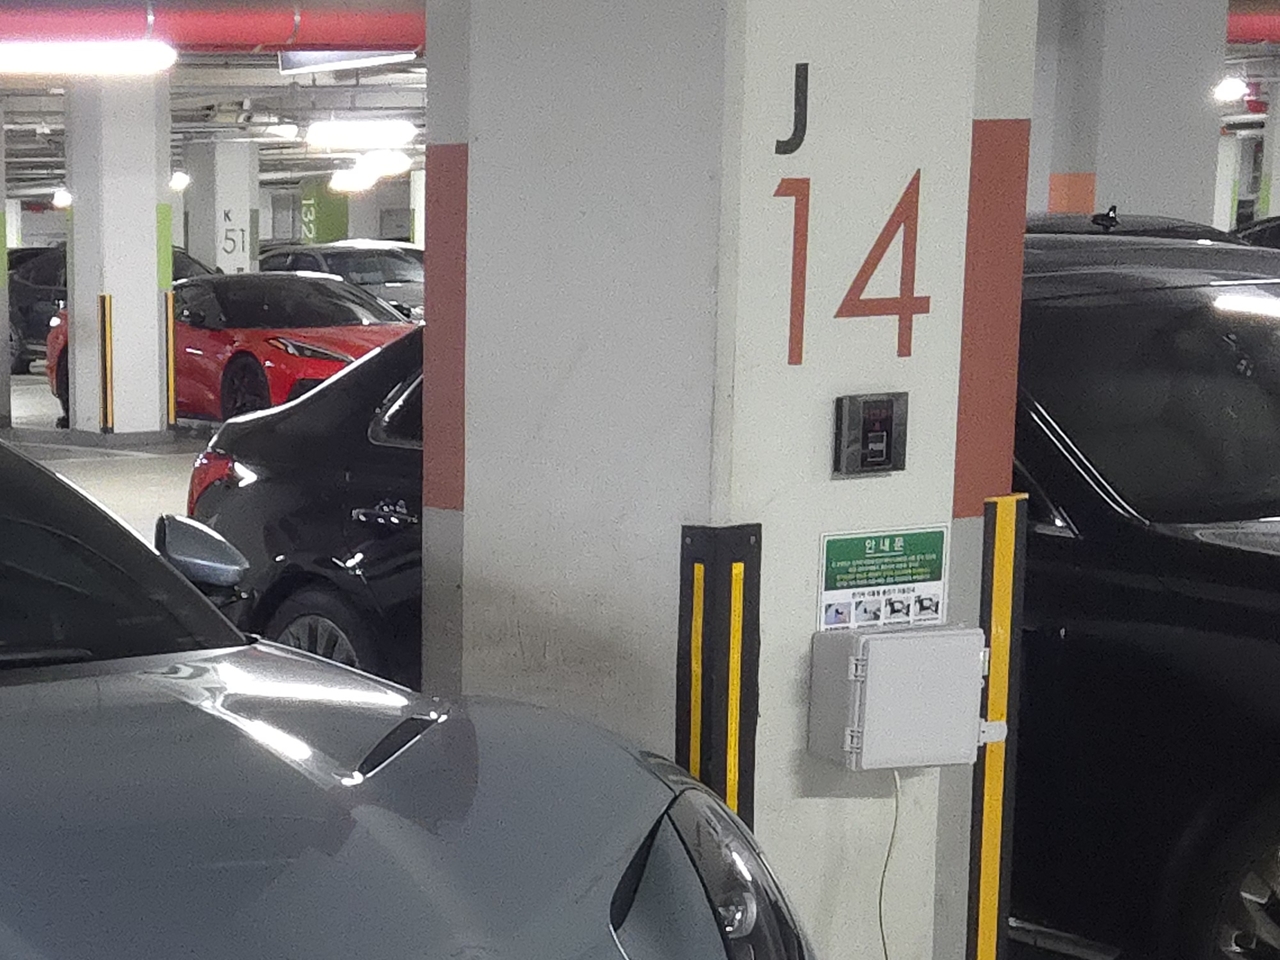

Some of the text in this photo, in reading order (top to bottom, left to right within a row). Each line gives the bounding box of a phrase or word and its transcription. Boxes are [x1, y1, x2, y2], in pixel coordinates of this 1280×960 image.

[775, 62, 809, 155] J
[223, 209, 232, 222] K
[301, 198, 316, 239] 132
[222, 228, 246, 254] 51
[773, 168, 931, 365] 14
